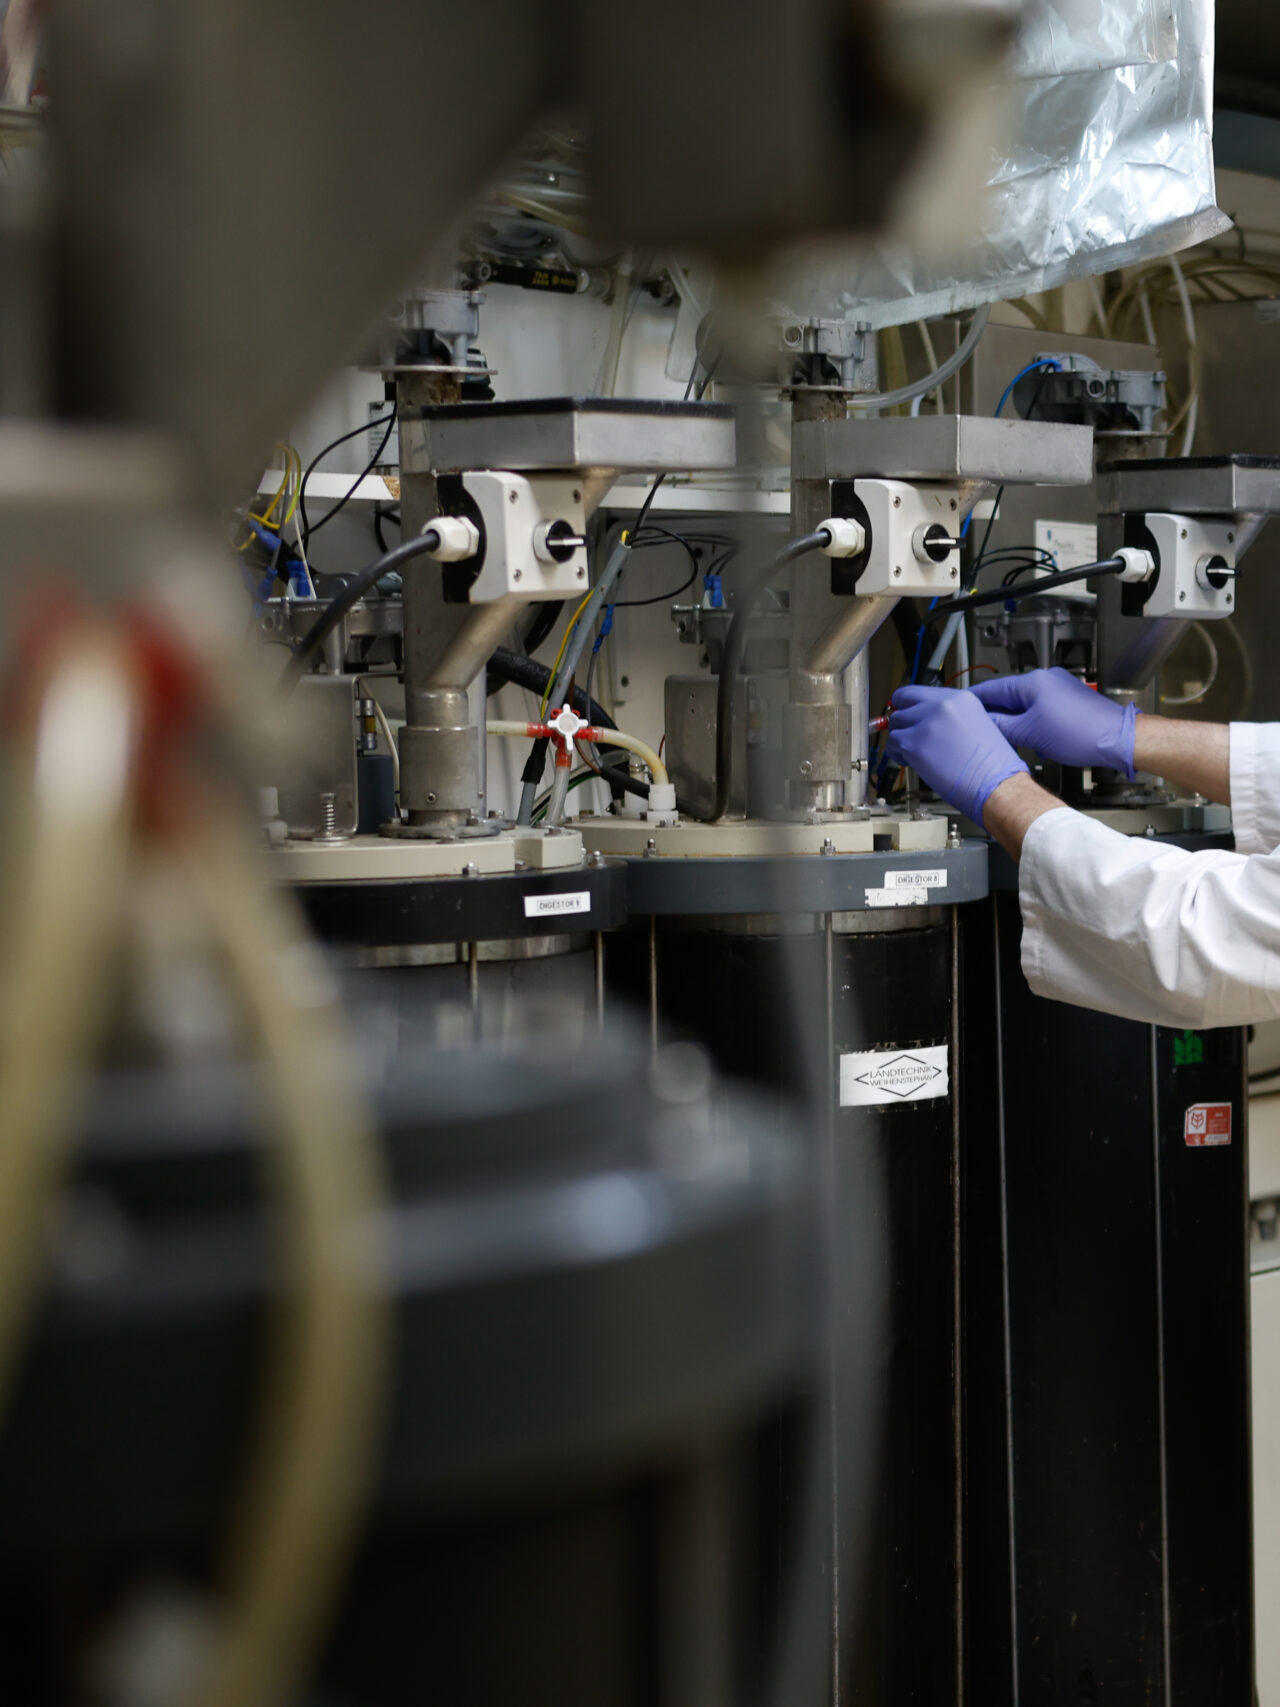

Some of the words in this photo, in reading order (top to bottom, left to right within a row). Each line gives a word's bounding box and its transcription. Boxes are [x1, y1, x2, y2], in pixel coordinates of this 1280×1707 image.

[539, 901, 574, 910] DIGESTOR
[869, 1065, 932, 1079] LANDTECHNIK
[869, 1074, 933, 1087] WEIHENSTEPHAN
